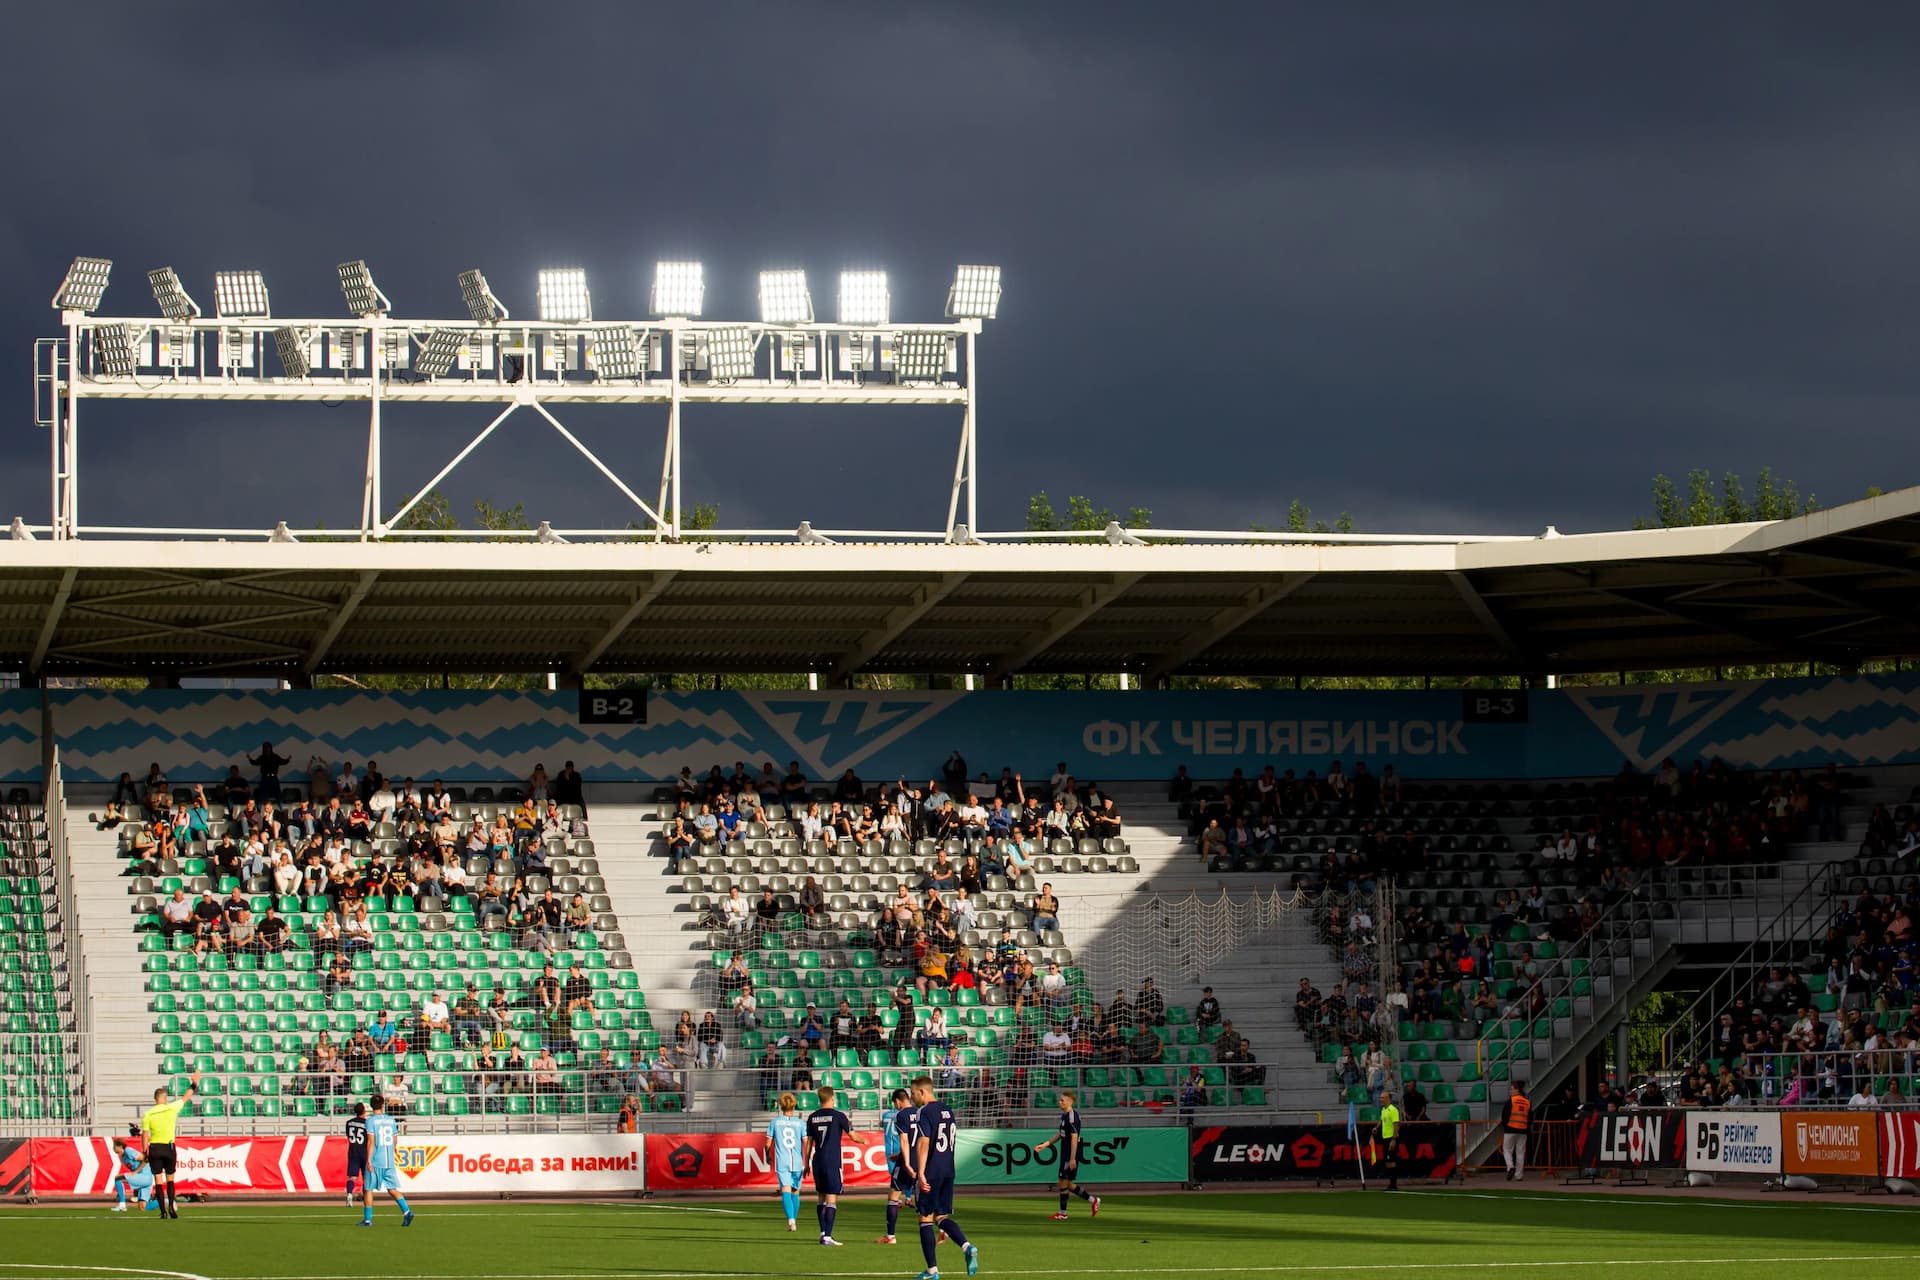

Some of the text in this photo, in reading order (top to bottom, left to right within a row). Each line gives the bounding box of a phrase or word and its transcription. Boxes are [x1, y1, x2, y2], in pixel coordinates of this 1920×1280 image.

[1082, 719, 1470, 757] ФК ЧЕЛЯБИНСК
[348, 1127, 366, 1145] 55
[378, 1126, 394, 1147] 18
[782, 1127, 796, 1150] 8
[817, 1125, 828, 1149] 7
[1600, 1115, 1663, 1163] LEON
[1724, 1121, 1758, 1142] РЕЙТИНГ
[1808, 1124, 1860, 1147] ЧЕМПИОНАТ
[207, 1157, 239, 1169] Банк
[448, 1151, 637, 1174] Победа за нами!
[1213, 1142, 1285, 1164] LEON
[1723, 1145, 1773, 1164] БУКМЕКЕРОВ
